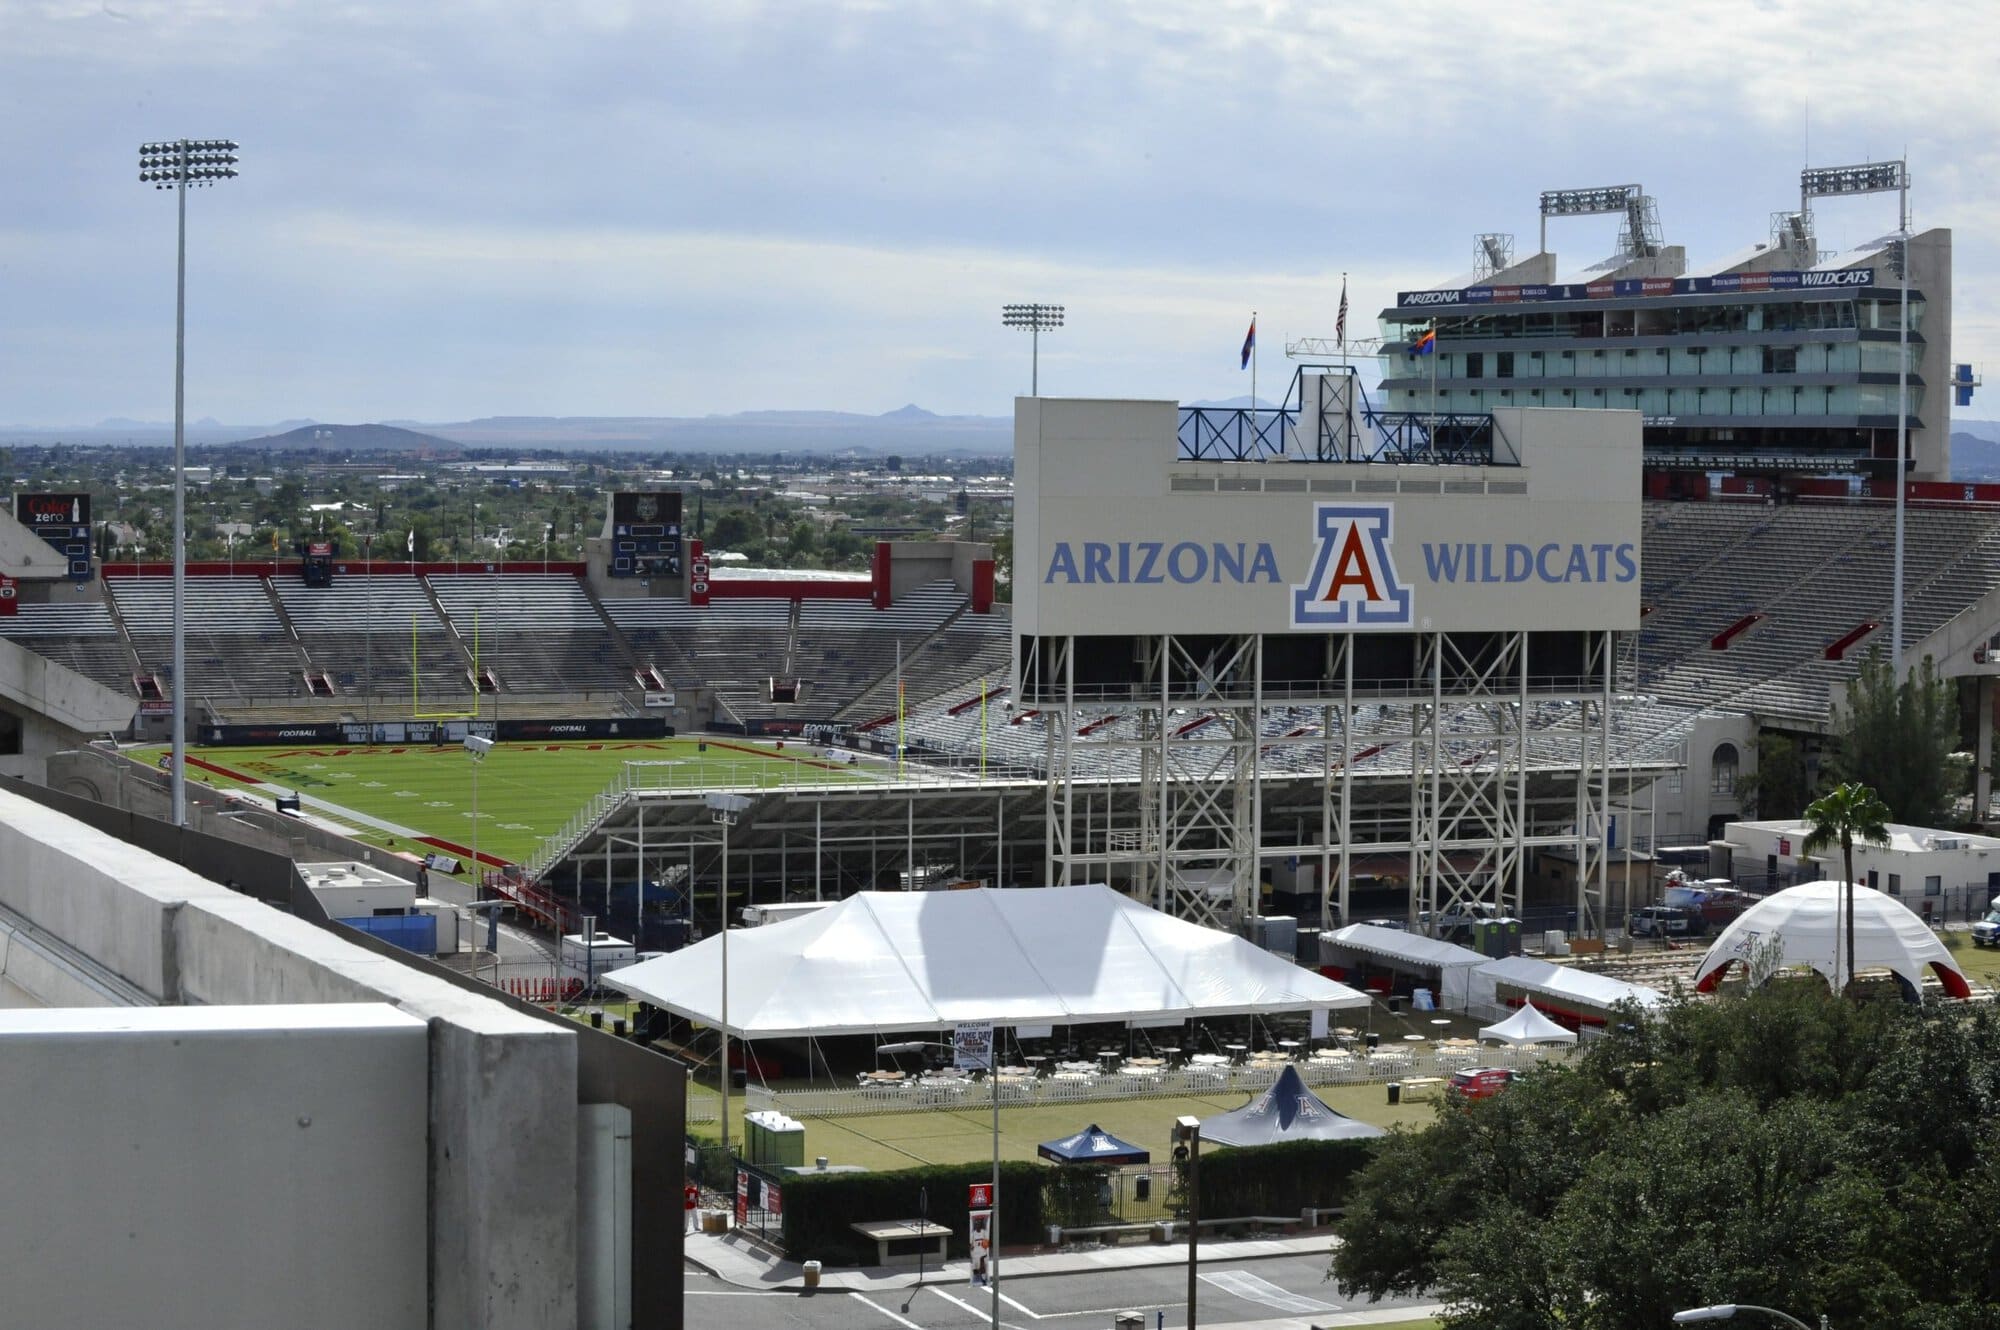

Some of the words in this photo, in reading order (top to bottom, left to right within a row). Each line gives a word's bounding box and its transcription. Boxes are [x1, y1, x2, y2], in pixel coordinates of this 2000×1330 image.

[1801, 270, 1871, 286] WILDCATS
[1403, 291, 1460, 305] ARIZONA
[28, 498, 70, 514] Coke
[36, 513, 64, 522] zero
[1044, 541, 1282, 585] ARIZONA
[1421, 542, 1637, 584] WILDCATS
[406, 723, 434, 732] MUSCLE
[469, 722, 496, 731] MUSCLE
[278, 729, 318, 737] FOOTBALL
[411, 732, 430, 741] MILK
[956, 1031, 977, 1044] GAME
[977, 1030, 992, 1043] DAY
